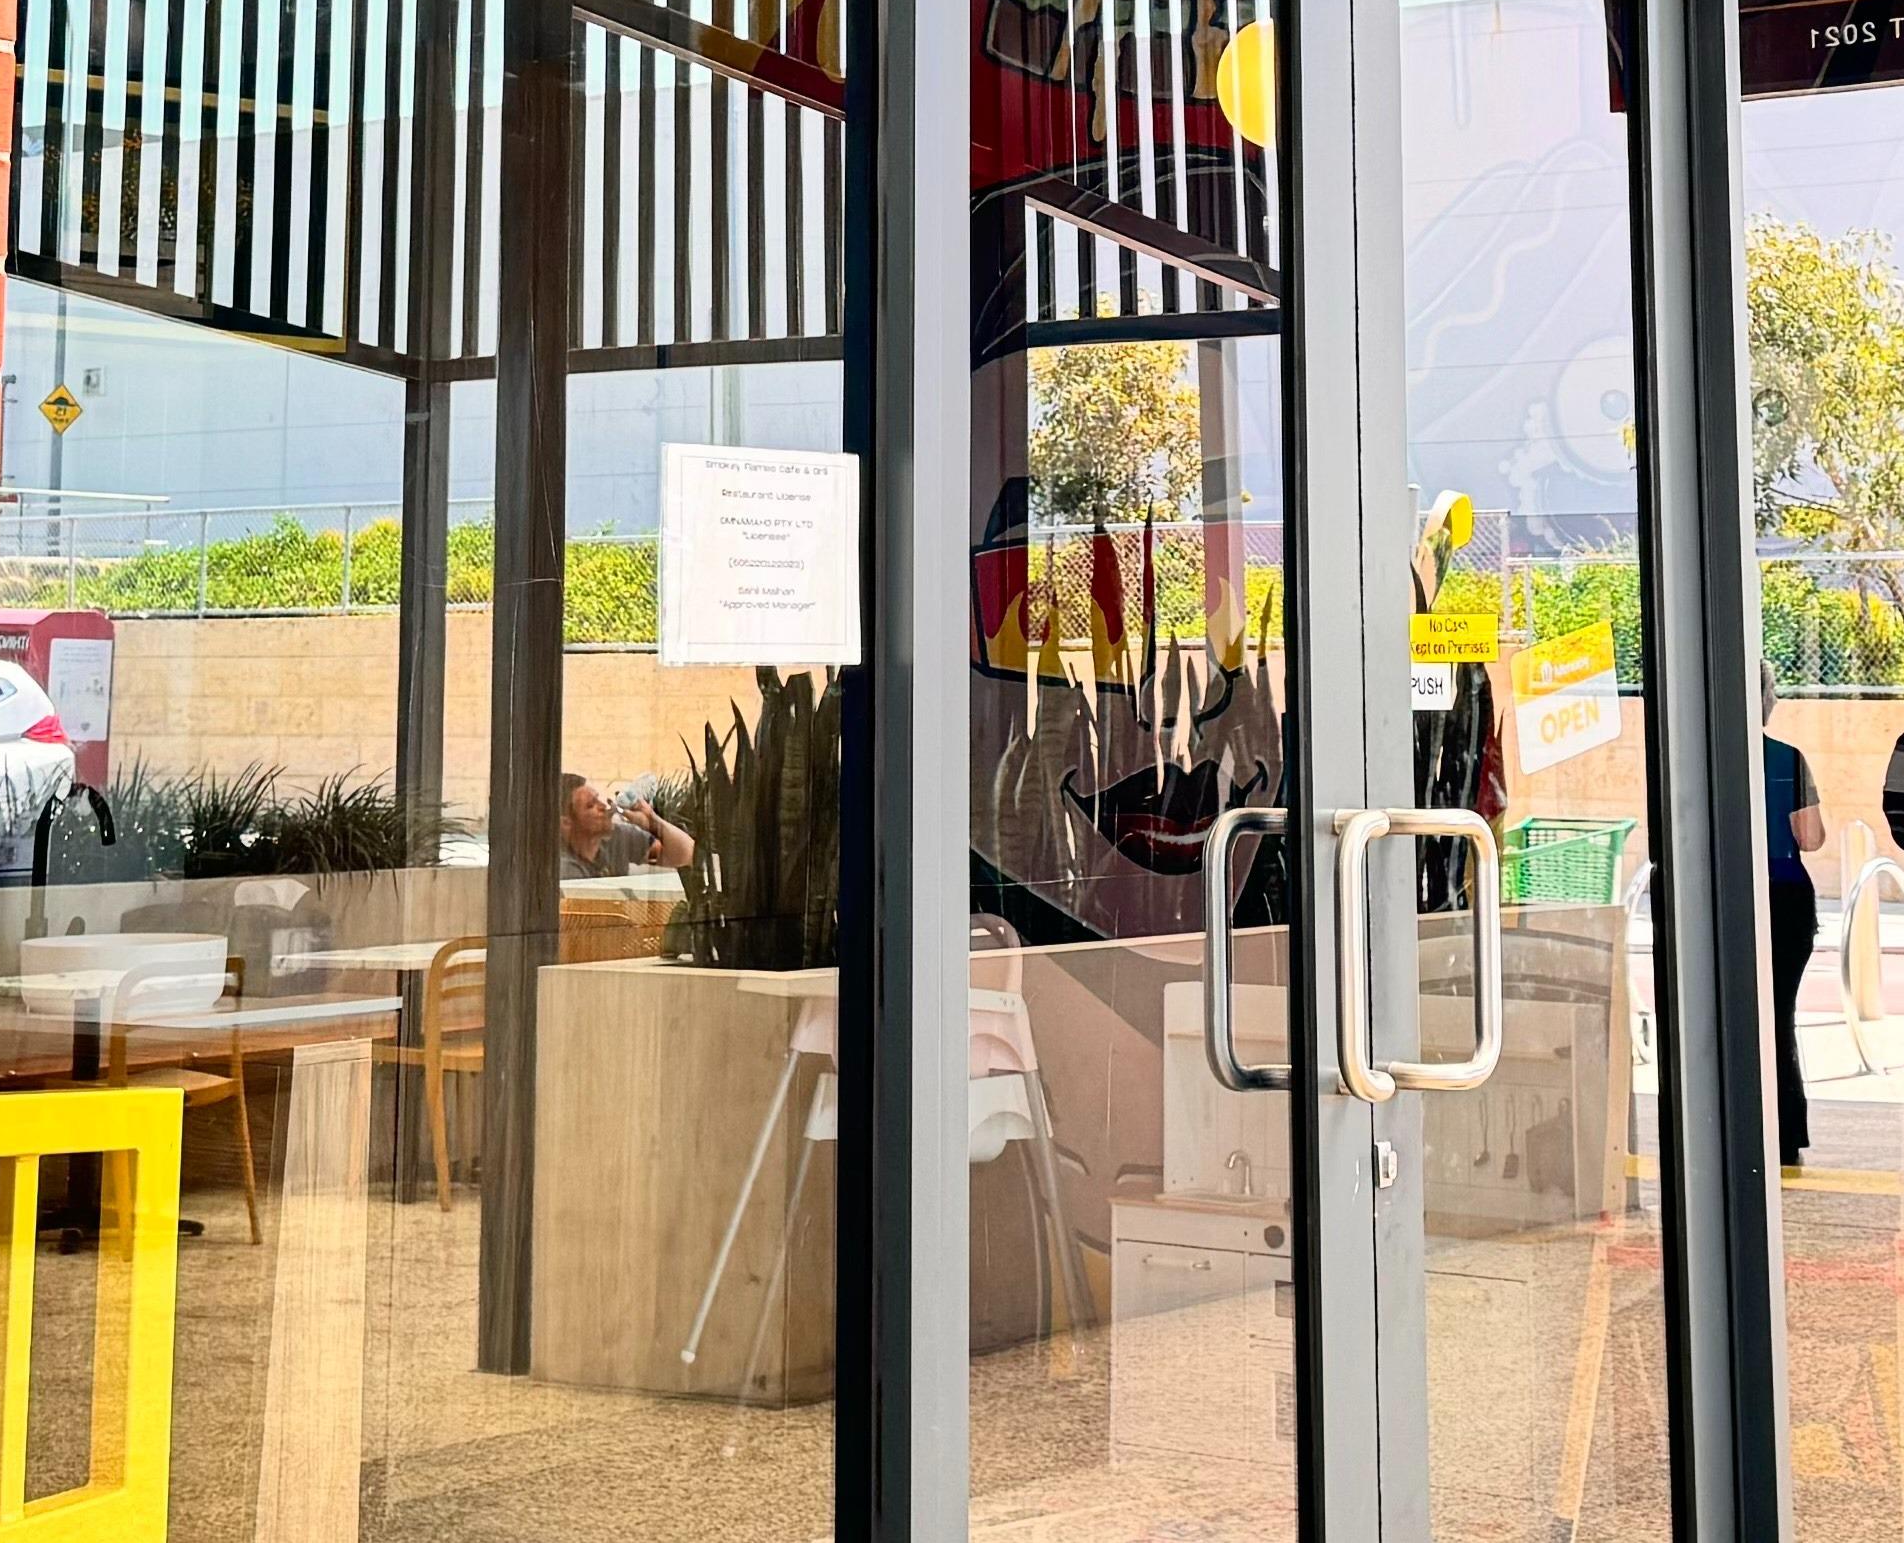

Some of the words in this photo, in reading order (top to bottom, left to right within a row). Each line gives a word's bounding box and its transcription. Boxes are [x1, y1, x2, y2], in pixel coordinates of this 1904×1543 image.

[1429, 618, 1443, 632] No
[1411, 677, 1443, 695] PUSH
[1540, 696, 1601, 744] OPEN
